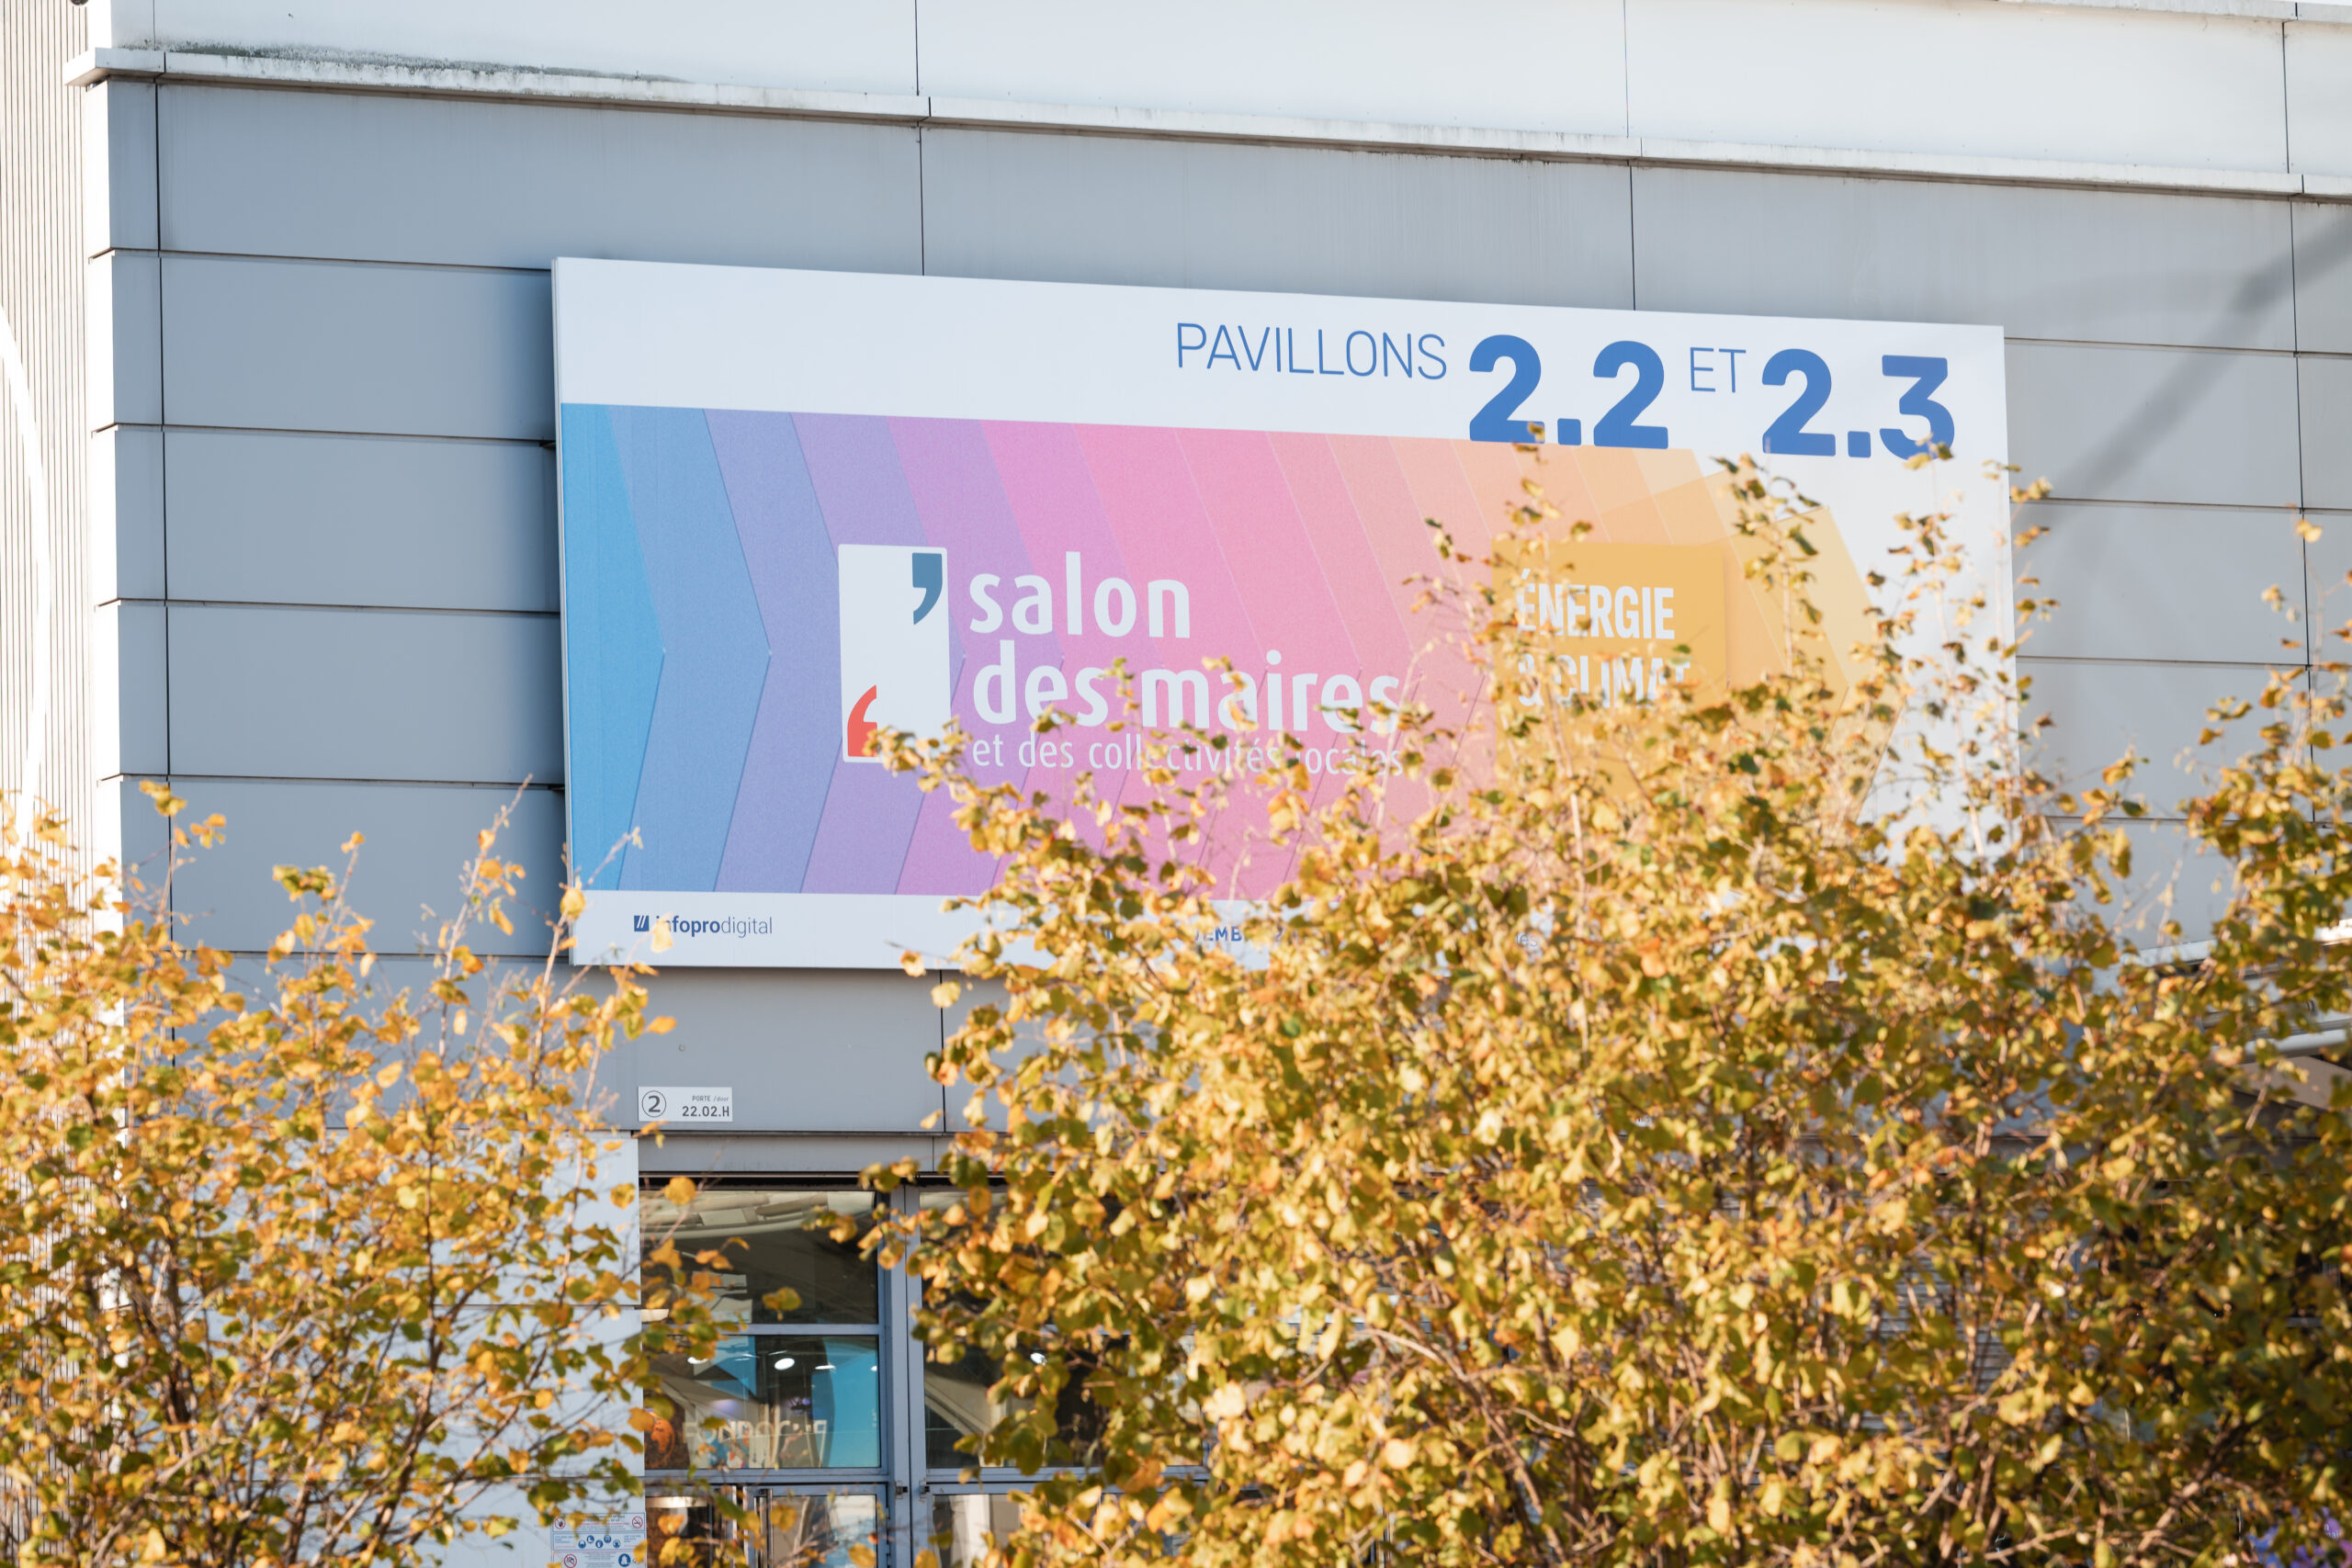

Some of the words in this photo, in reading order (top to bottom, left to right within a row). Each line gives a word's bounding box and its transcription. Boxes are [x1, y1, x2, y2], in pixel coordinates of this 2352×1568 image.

[1176, 321, 1448, 380] PAVILLONS
[1468, 333, 1669, 450] 2.2
[1689, 346, 1747, 394] ET
[1761, 347, 1955, 461] 2.3
[969, 551, 1191, 638] salon
[1516, 568, 1676, 640] ÉNERGIE
[972, 639, 1110, 727] des
[1140, 649, 1400, 735] maires
[972, 734, 1004, 768] et
[1018, 729, 1074, 769] des
[655, 914, 773, 939] foprodigital
[648, 1095, 661, 1113] 2
[682, 1105, 730, 1118] 22.02.H
